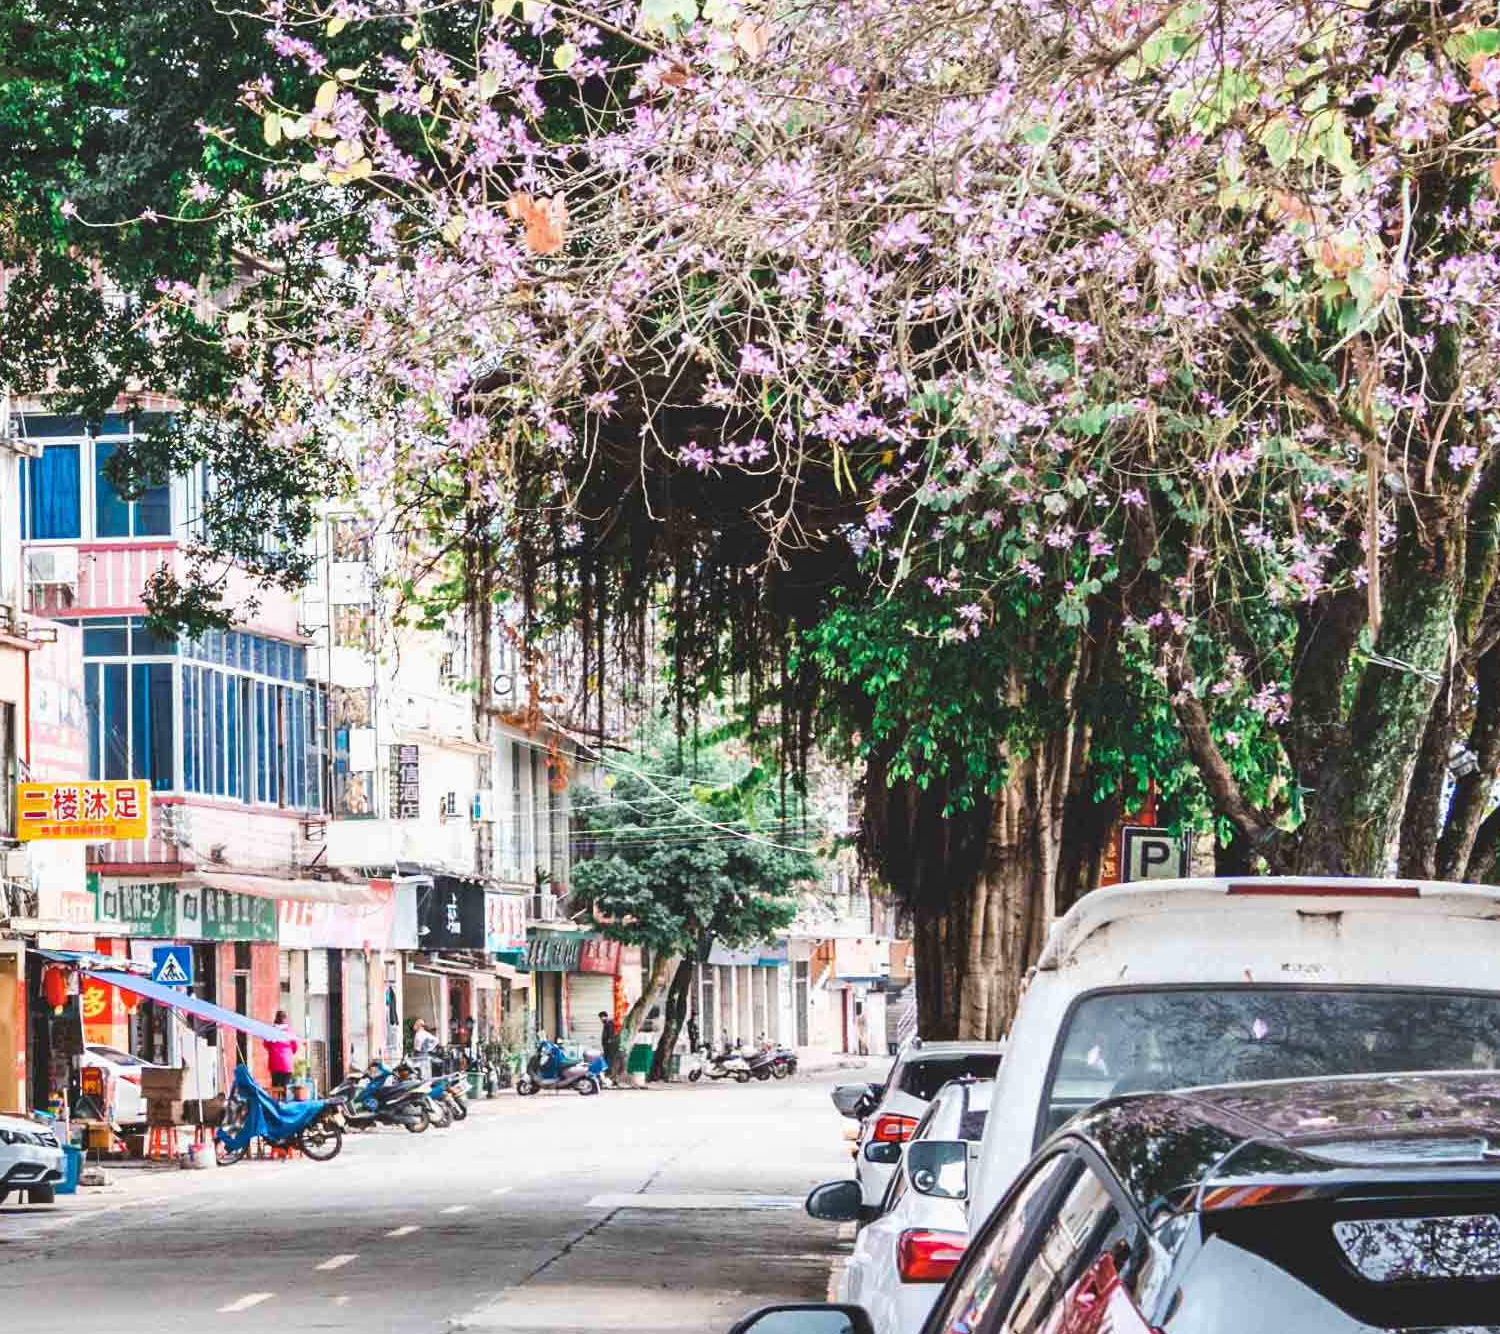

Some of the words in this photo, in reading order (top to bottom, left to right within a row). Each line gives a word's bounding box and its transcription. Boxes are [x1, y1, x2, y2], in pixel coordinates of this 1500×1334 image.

[22, 787, 140, 820] 二楼沐足
[1141, 840, 1170, 878] P
